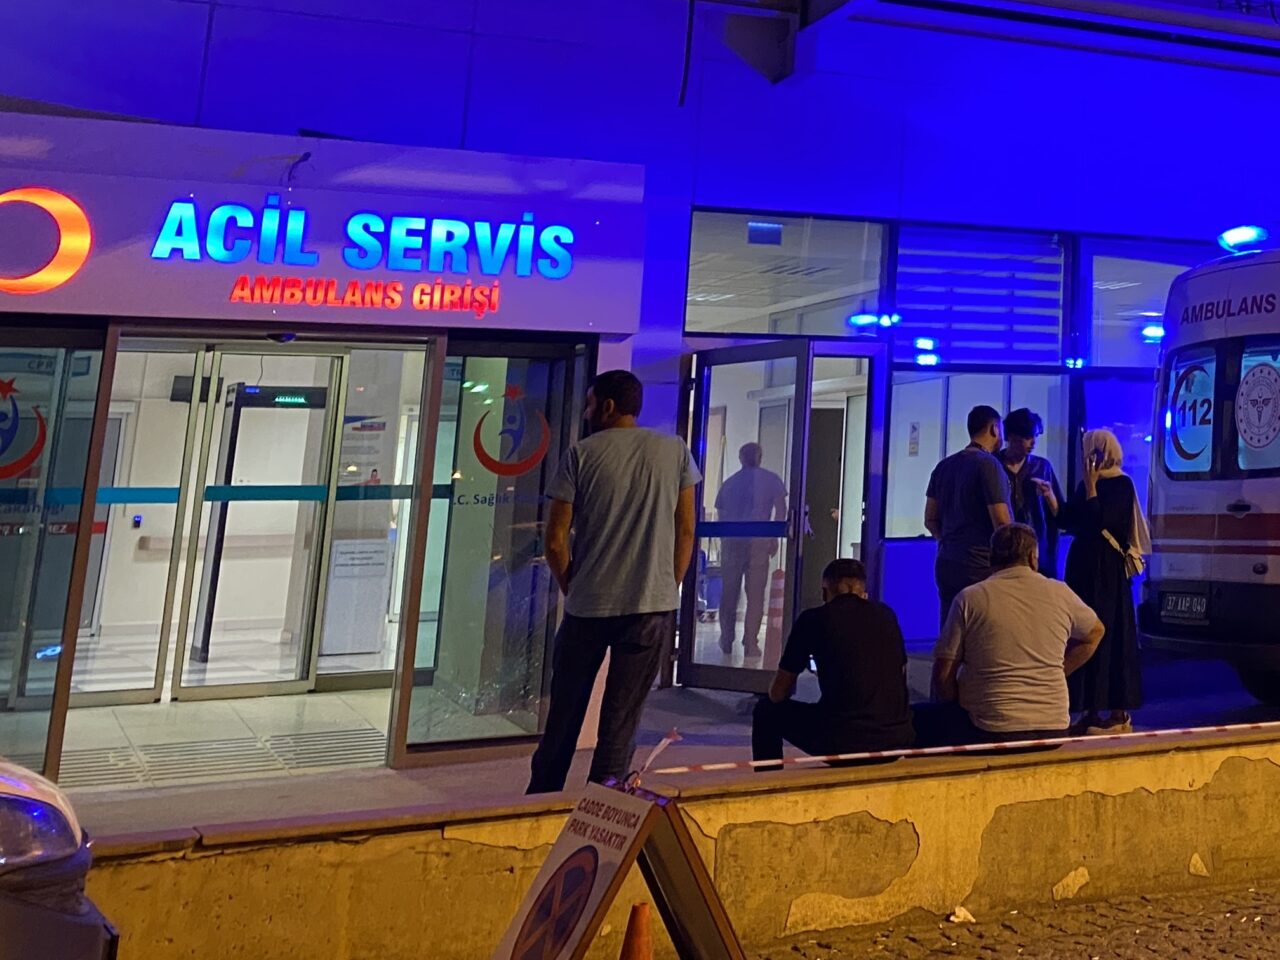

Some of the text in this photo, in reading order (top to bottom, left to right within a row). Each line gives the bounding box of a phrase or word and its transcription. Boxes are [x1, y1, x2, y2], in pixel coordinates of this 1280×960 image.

[151, 193, 575, 279] ACİL SERVİS
[230, 274, 500, 320] AMBULANS GİRİŞİ
[1180, 293, 1277, 325] AMBULANS
[1178, 398, 1212, 428] 112
[577, 797, 641, 830] CADDE BOYUNCA
[567, 818, 628, 851] PARK YASAKTIR
